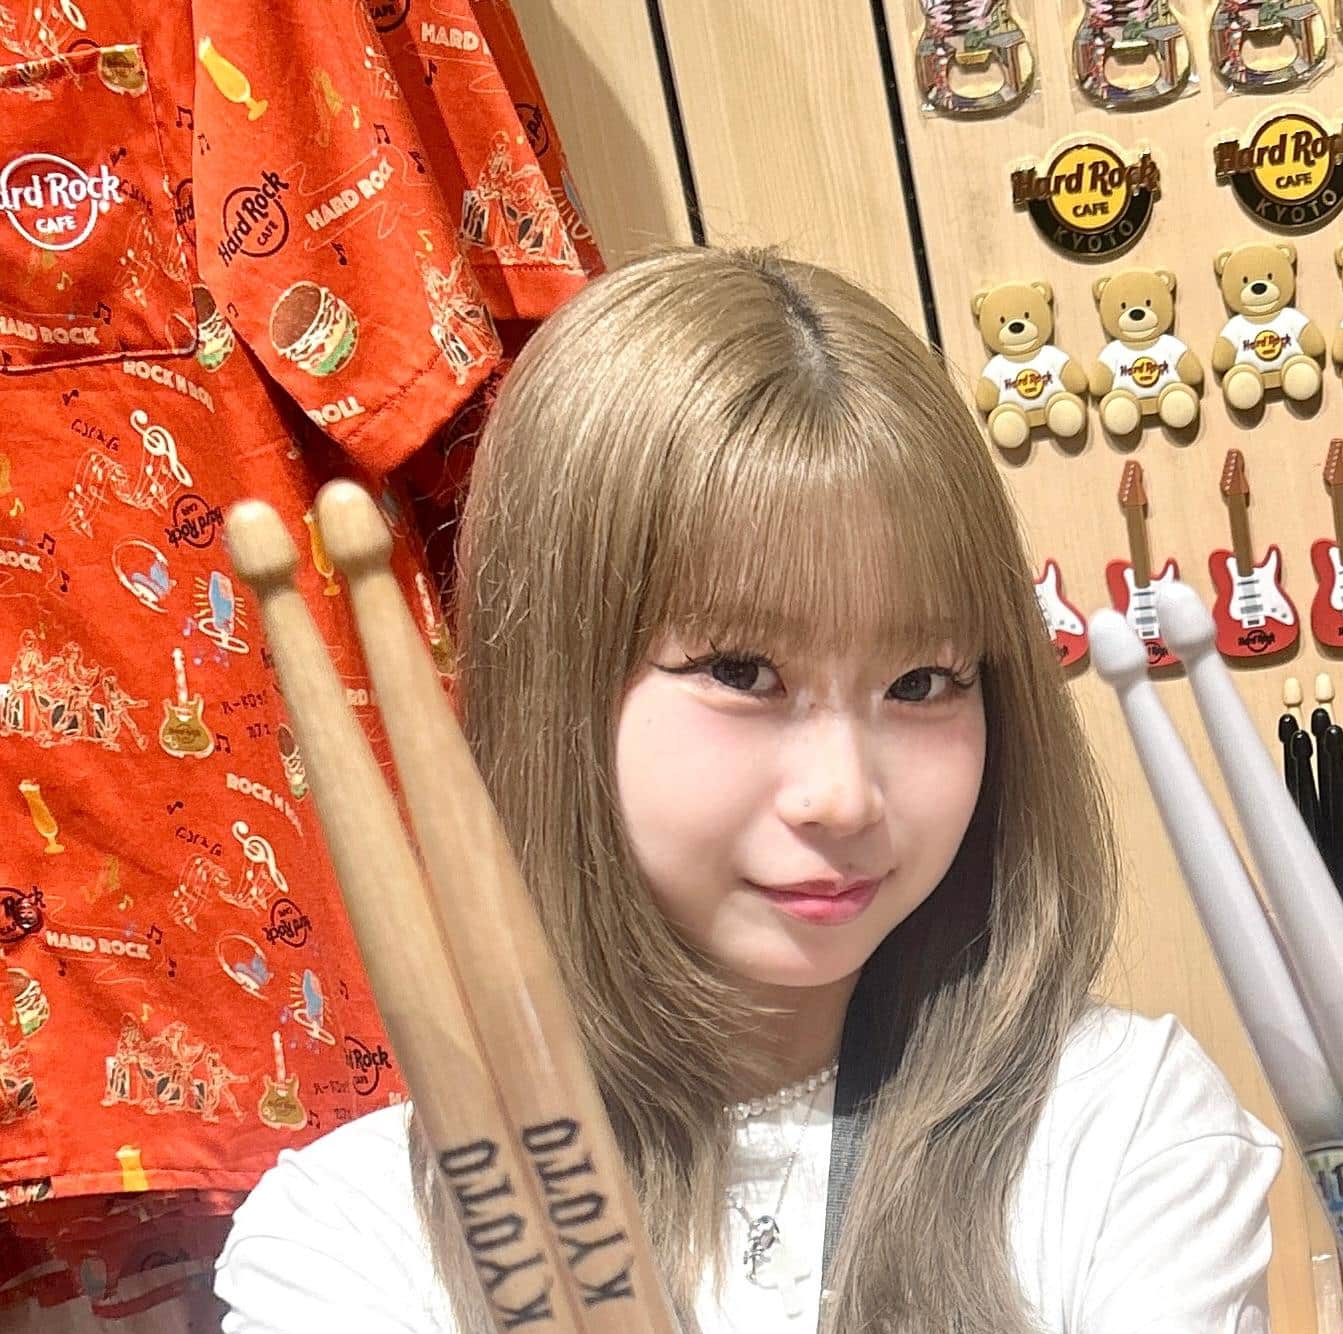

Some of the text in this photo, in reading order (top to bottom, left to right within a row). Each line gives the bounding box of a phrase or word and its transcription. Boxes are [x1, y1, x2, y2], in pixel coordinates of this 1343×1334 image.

[420, 22, 480, 51] HARD
[44, 164, 124, 210] Rock
[1275, 172, 1312, 189] CAFE
[218, 170, 290, 268] Hard Rock
[304, 188, 361, 232] HARD
[1072, 202, 1110, 218] CAFE
[1256, 189, 1337, 223] KYOTO
[35, 215, 77, 234] CAFE
[256, 220, 279, 247] CAFE
[1054, 220, 1133, 251] KYOTO
[40, 326, 100, 345] ROCK
[46, 931, 151, 960] HARD ROCK
[523, 1118, 635, 1308] KYOTO
[440, 1138, 555, 1330] KYOTO
